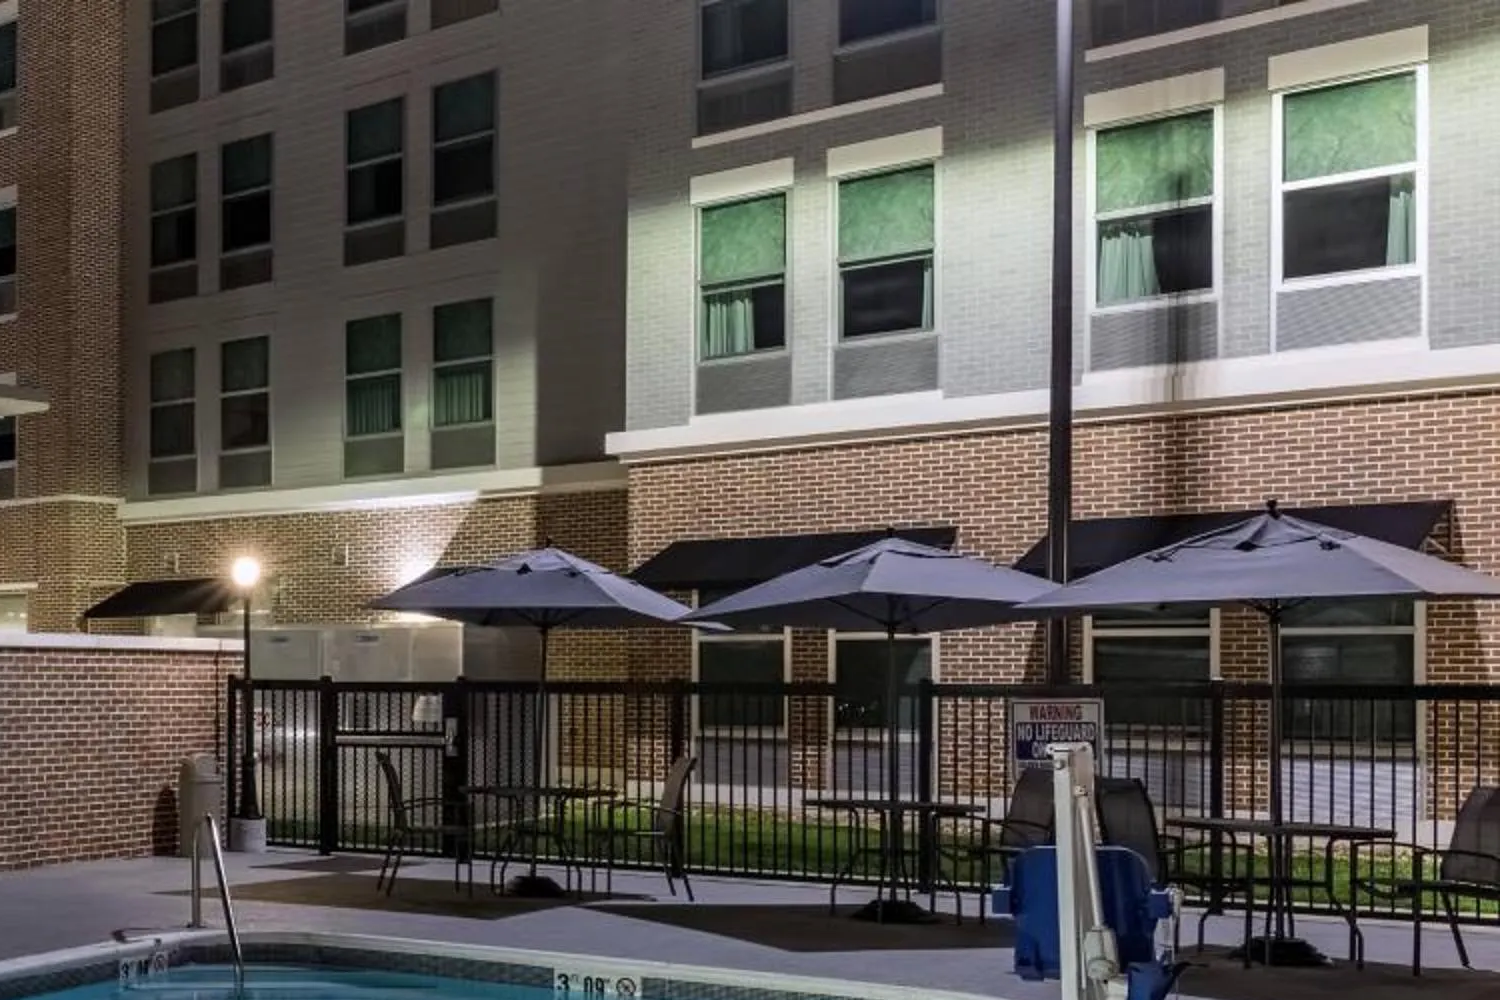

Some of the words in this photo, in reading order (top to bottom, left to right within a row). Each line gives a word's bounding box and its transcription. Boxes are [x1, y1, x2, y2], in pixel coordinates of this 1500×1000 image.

[1029, 705, 1083, 720] WARNING
[1017, 723, 1033, 741] NO
[1035, 723, 1095, 741] LIFEGUARD
